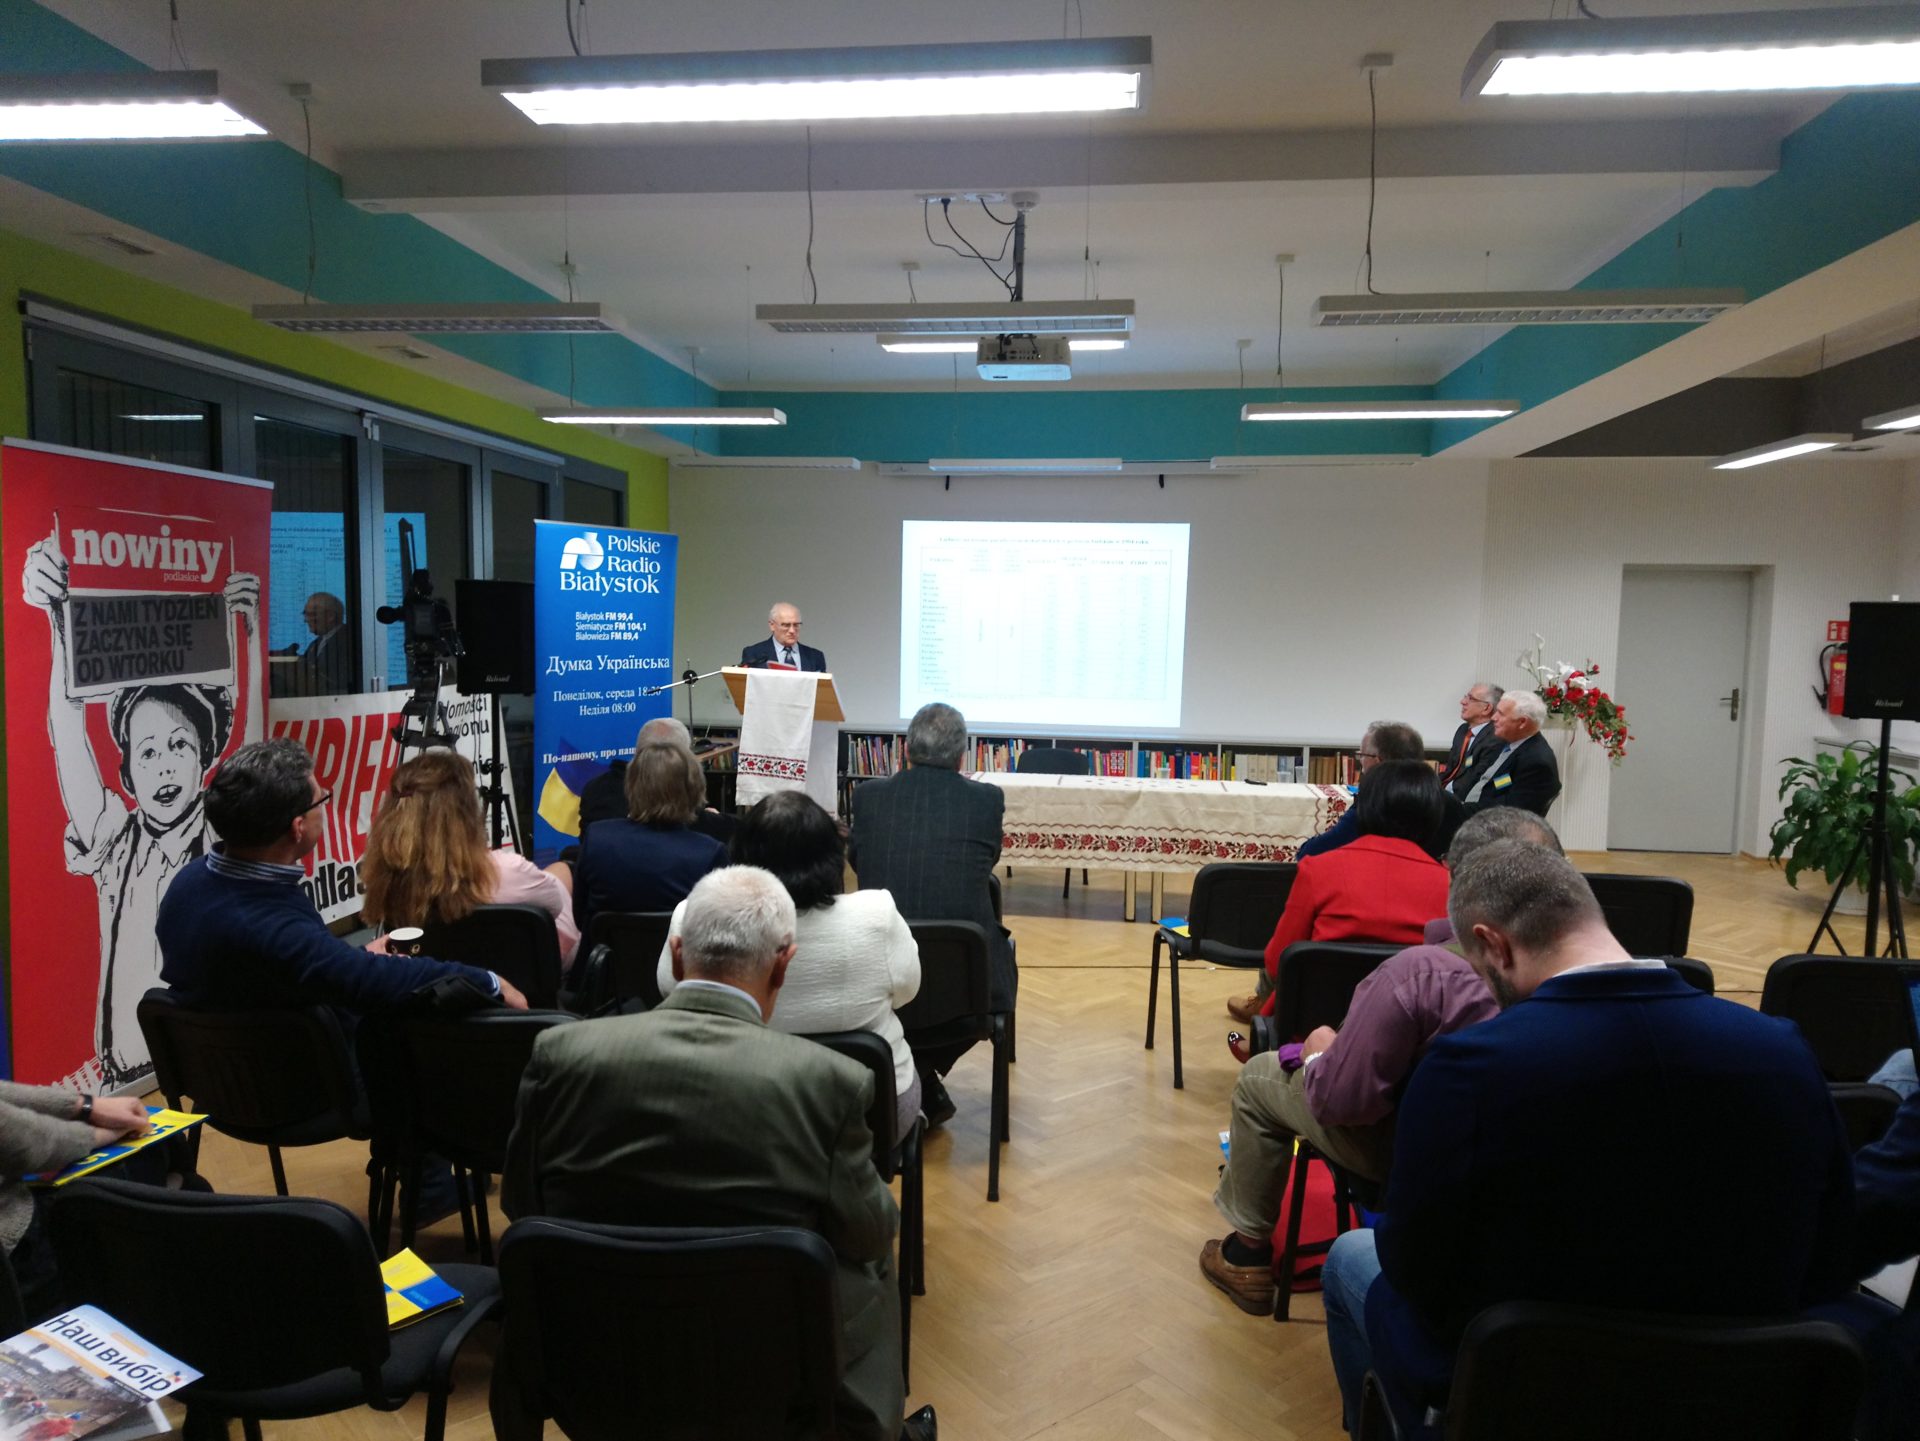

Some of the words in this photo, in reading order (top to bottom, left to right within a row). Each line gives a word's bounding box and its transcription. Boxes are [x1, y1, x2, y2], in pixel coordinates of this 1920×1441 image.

[71, 524, 223, 583] nowiny
[608, 535, 661, 554] Polskie
[607, 556, 661, 574] Radio
[163, 572, 200, 582] podlaskie
[560, 572, 660, 596] Białystok
[75, 601, 87, 626] Z
[92, 600, 138, 625] NAMI
[576, 612, 605, 622] Białystok
[605, 612, 616, 620] FM
[617, 612, 633, 622] 99,4
[576, 622, 613, 632] Siemiatycze
[615, 622, 626, 630] FM
[627, 622, 647, 631] 104,1
[611, 631, 622, 640] FM
[623, 632, 638, 641] 89,4
[76, 626, 159, 655] ZACZYNA
[164, 623, 193, 650] SIĘ
[77, 657, 104, 683] OD
[108, 649, 185, 679] WTORKU
[546, 656, 592, 675] Думка
[597, 654, 670, 674] Українська
[553, 689, 604, 701] Понеділок,
[606, 689, 635, 700] середа
[580, 704, 610, 716] Неділя
[612, 702, 636, 713] 08:00
[600, 749, 616, 759] про
[44, 1314, 105, 1351] Наш
[96, 1347, 172, 1392] вибір
